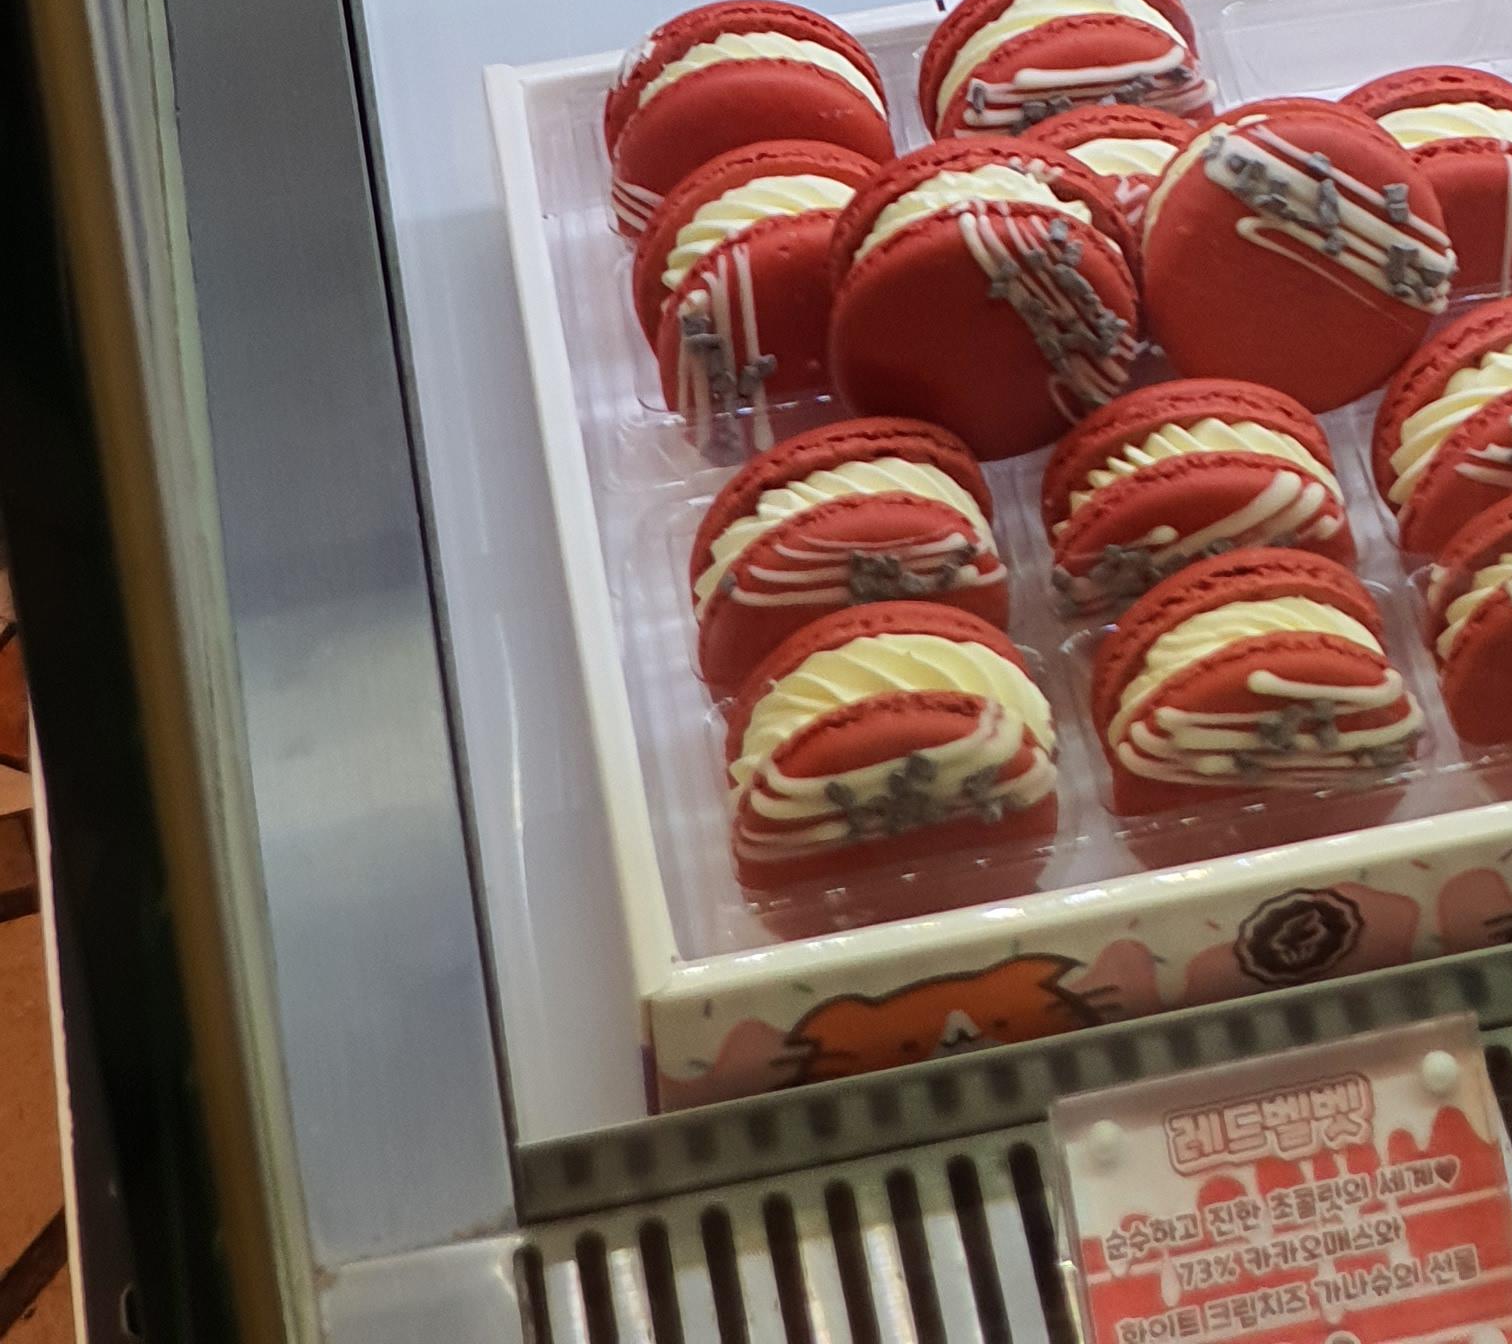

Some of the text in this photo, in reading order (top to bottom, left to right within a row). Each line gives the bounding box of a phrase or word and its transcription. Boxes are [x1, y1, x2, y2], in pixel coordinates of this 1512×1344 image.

[1169, 1078, 1368, 1164] 레드벨벳
[1104, 1212, 1201, 1263] 순수하고
[1206, 1200, 1263, 1241] 진한
[1268, 1174, 1370, 1223] 초콜릿의
[1177, 1215, 1406, 1289] 73% 카카오매스와
[1206, 1286, 1310, 1331] 크림치즈
[1312, 1259, 1423, 1306] 가나슈의
[1428, 1244, 1479, 1281] 선물
